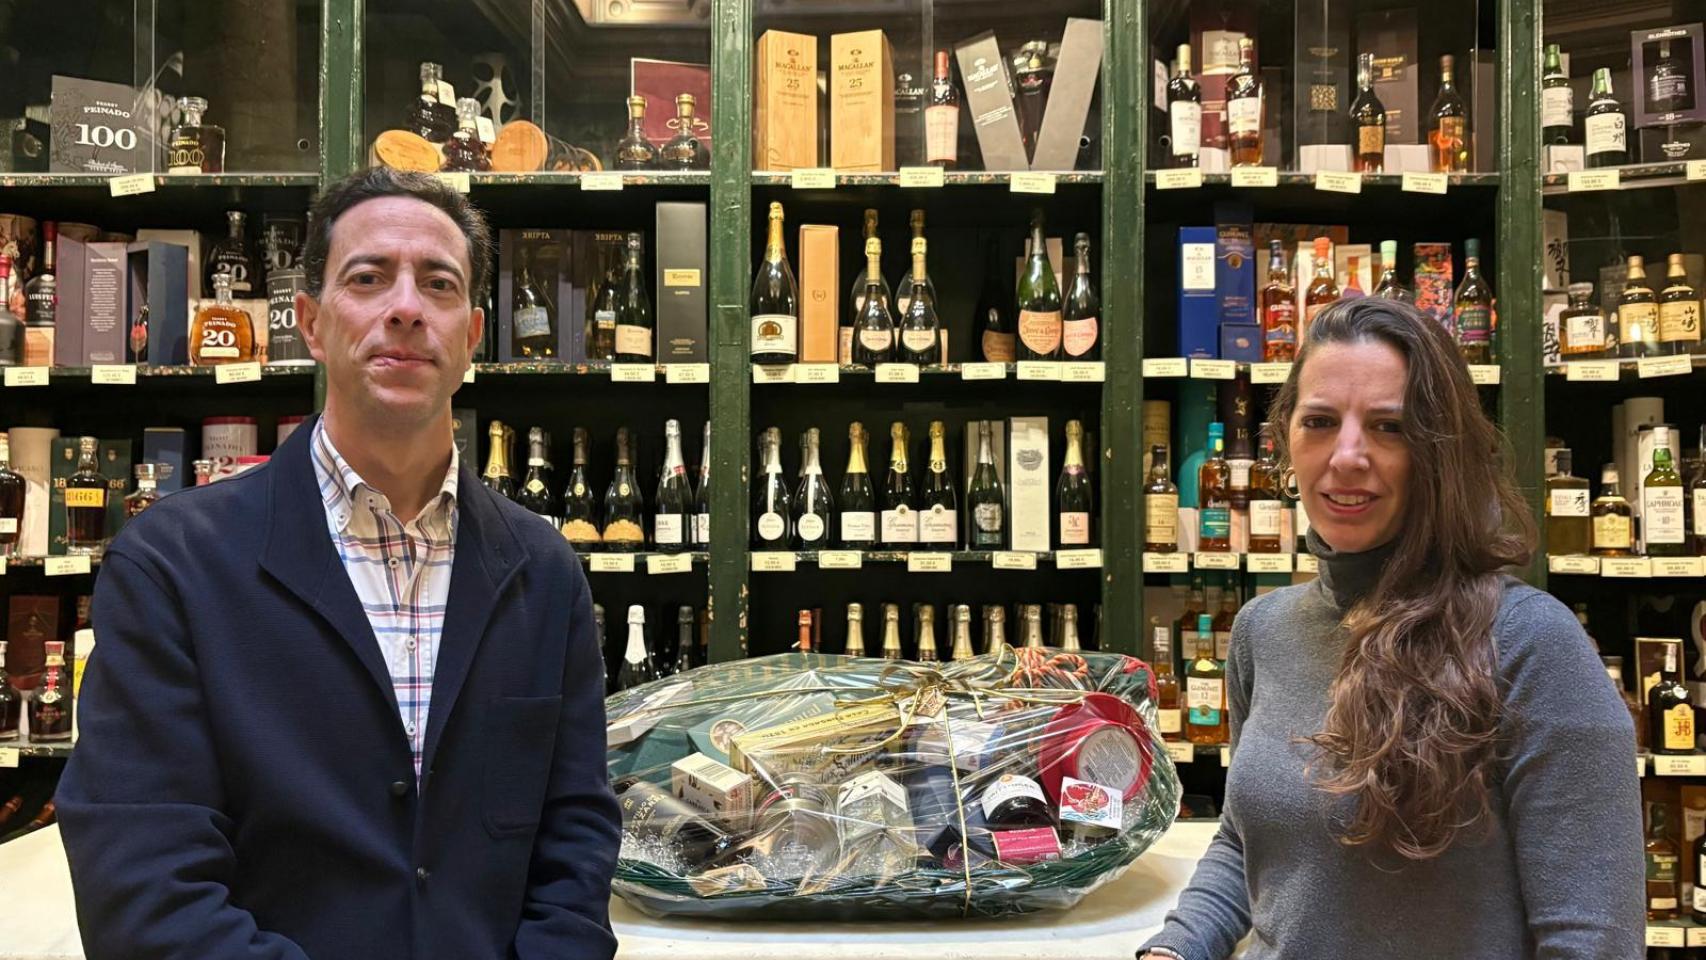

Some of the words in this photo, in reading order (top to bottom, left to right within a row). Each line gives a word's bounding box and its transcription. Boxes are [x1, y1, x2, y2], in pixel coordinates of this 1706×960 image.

[786, 78, 799, 88] 25
[849, 78, 862, 88] 25
[84, 107, 131, 118] PEINADO
[75, 123, 137, 150] 100
[169, 149, 205, 166] 100
[270, 307, 297, 329] 20
[202, 329, 236, 346] 20
